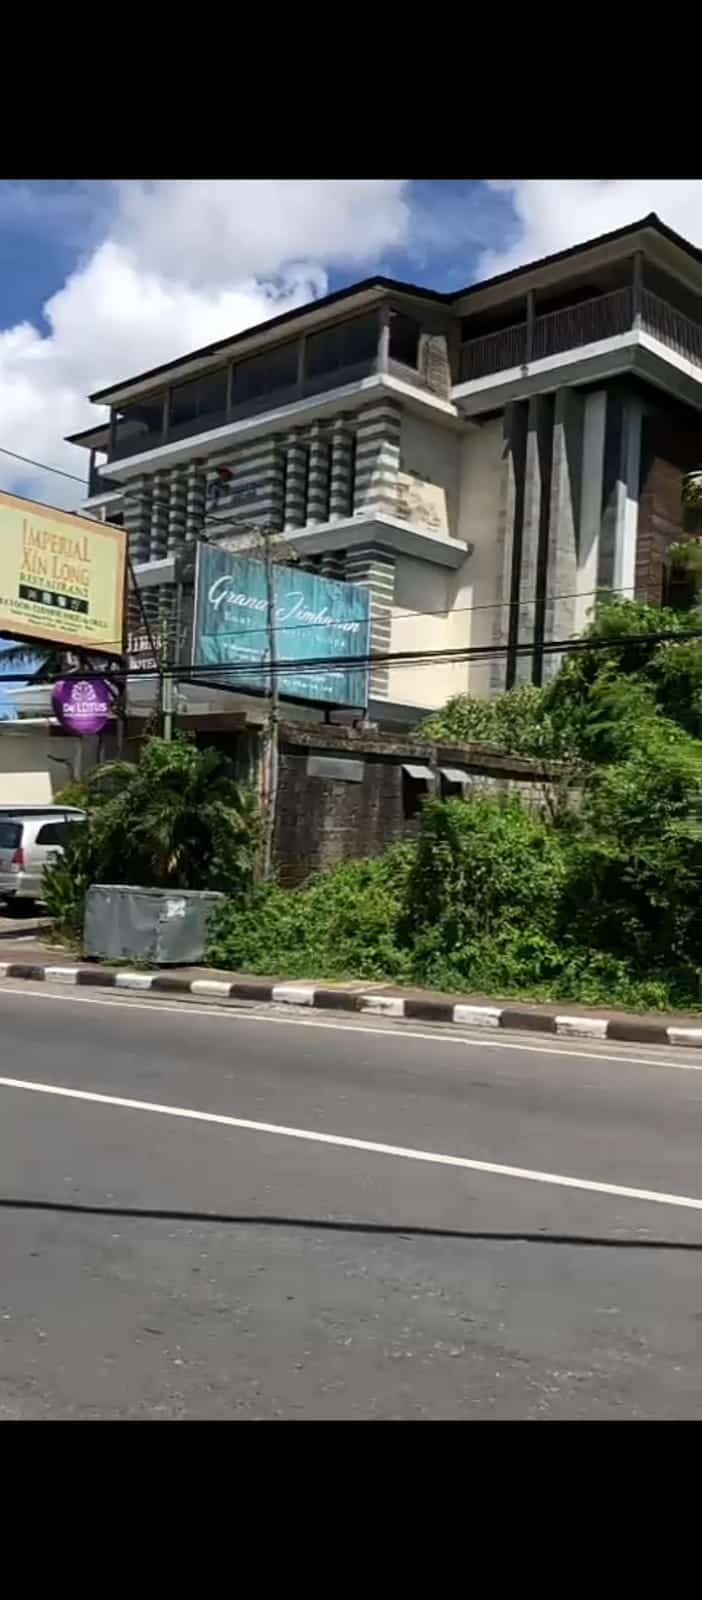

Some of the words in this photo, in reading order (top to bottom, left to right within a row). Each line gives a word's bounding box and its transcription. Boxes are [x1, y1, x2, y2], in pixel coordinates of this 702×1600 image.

[23, 518, 91, 562] IMPERIAL
[20, 571, 89, 598] RESTAURANT
[51, 555, 89, 586] LONG
[76, 702, 107, 713] LOTUS
